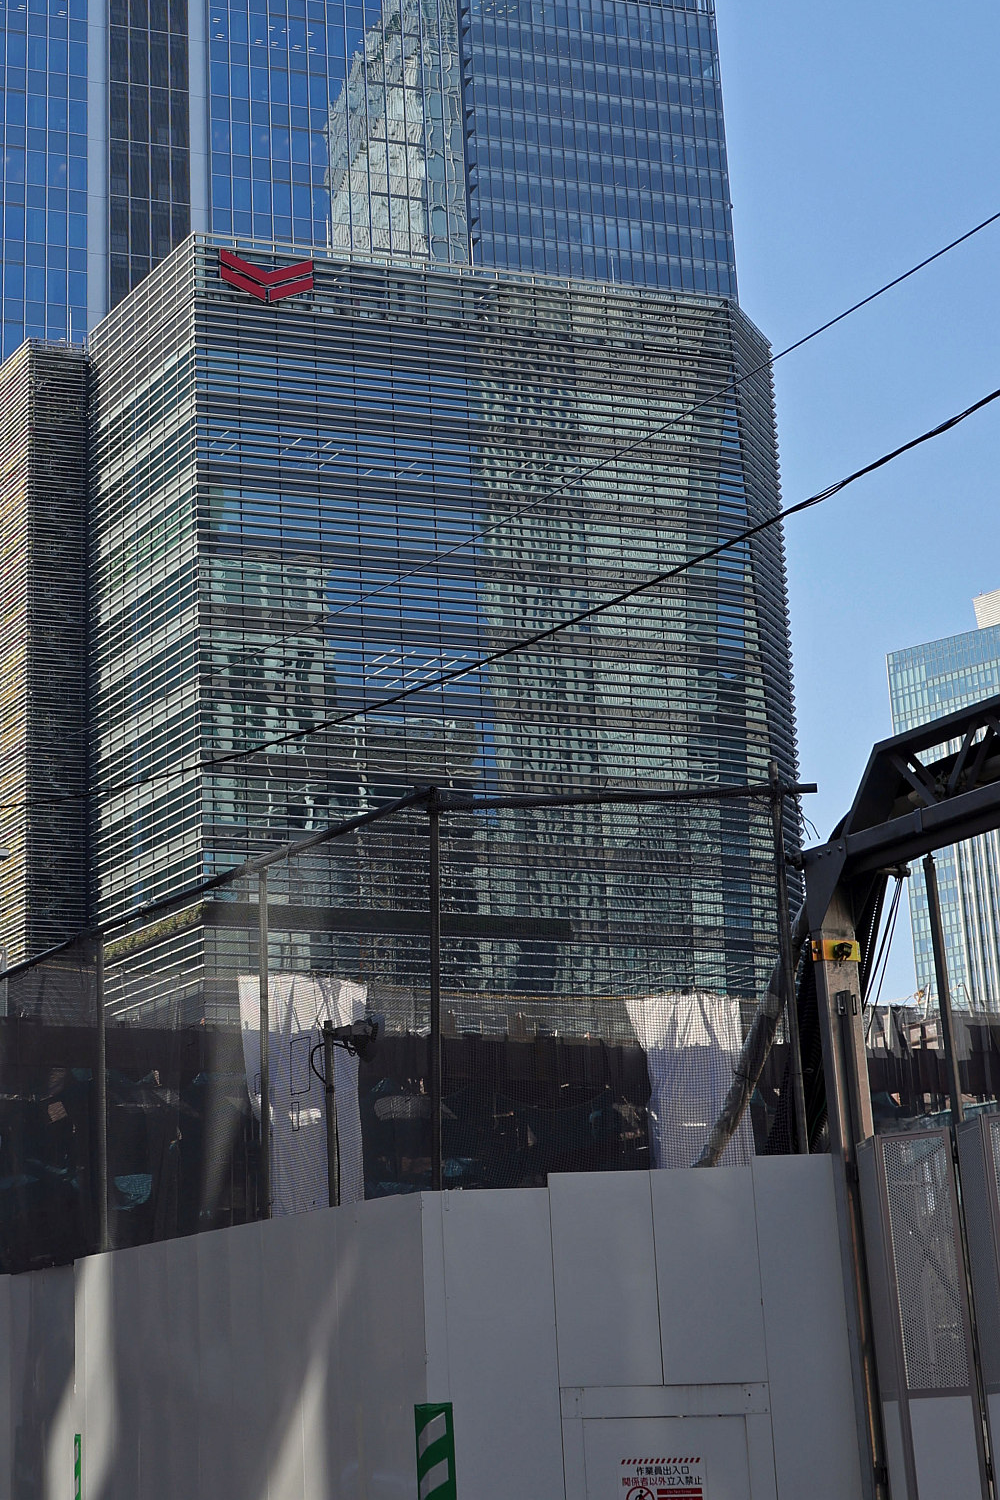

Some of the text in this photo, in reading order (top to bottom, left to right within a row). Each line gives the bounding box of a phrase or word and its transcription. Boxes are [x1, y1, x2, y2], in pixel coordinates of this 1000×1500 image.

[636, 1465, 690, 1476] 作業員出入口
[622, 1476, 703, 1487] 関係者以外立入禁止
